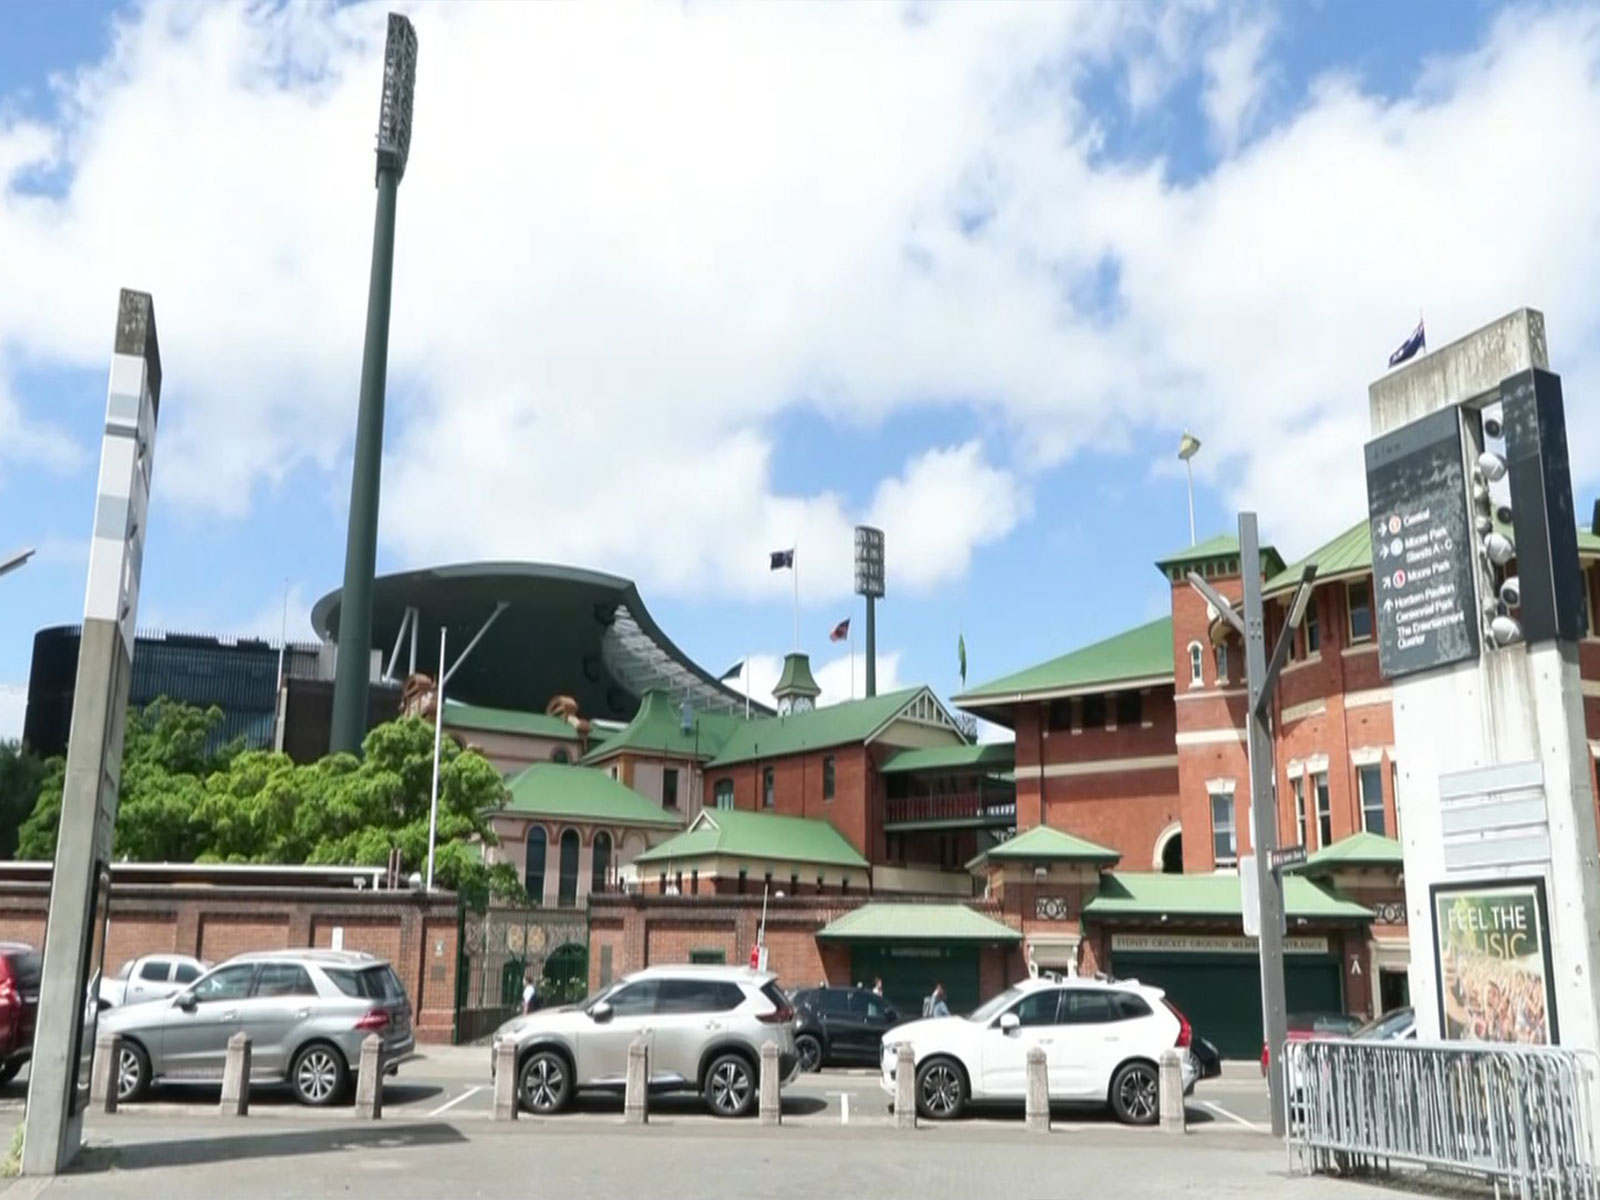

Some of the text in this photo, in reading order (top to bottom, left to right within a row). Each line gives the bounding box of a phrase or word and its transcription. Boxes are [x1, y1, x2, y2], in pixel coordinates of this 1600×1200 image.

[1429, 526, 1448, 541] Park
[1407, 560, 1451, 582] Moore Park
[1435, 598, 1454, 613] Park
[1397, 626, 1412, 639] The
[1448, 904, 1528, 931] FEEL THE
